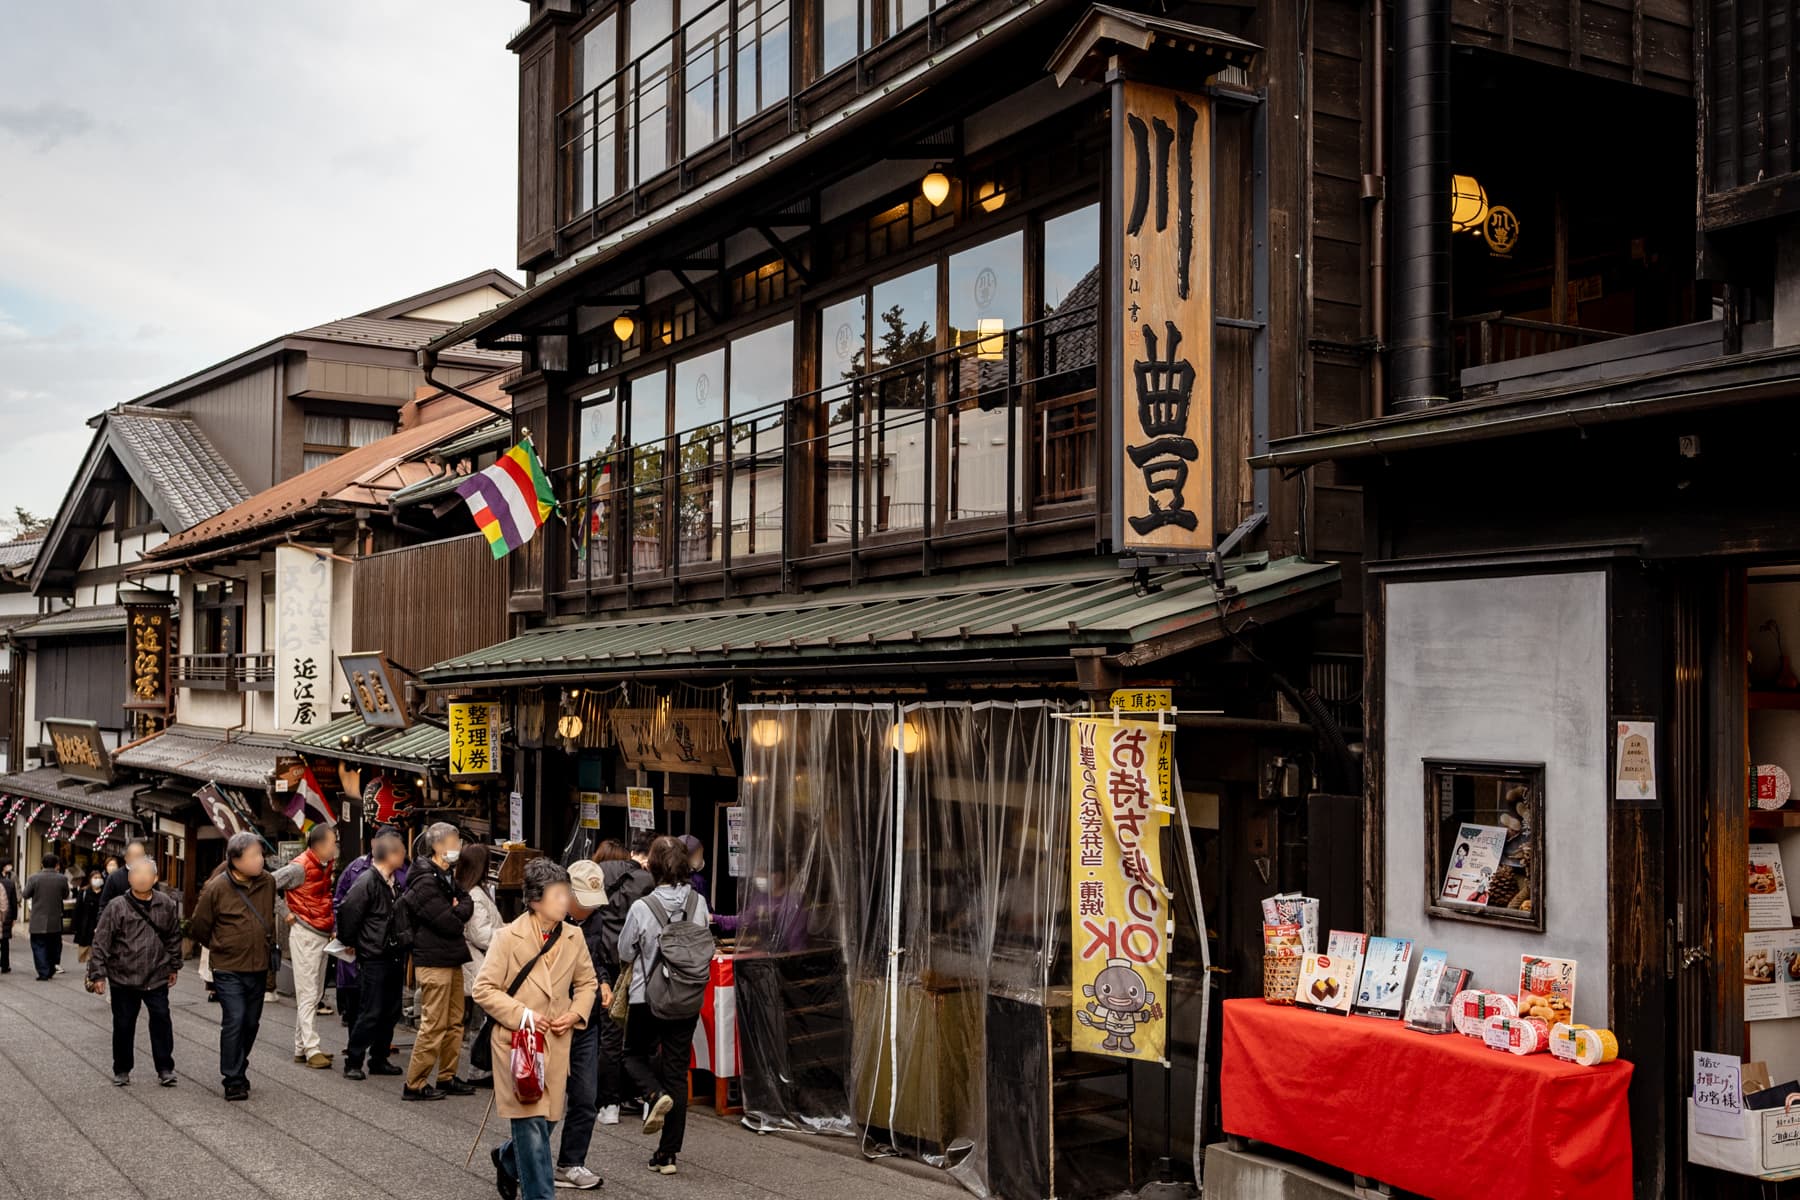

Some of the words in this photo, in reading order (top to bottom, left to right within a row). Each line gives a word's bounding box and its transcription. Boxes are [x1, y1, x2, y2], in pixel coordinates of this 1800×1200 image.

[1126, 96, 1199, 536] 川豊
[292, 657, 318, 725] 近江屋
[454, 709, 465, 748] こちら
[468, 705, 488, 769] 整理券
